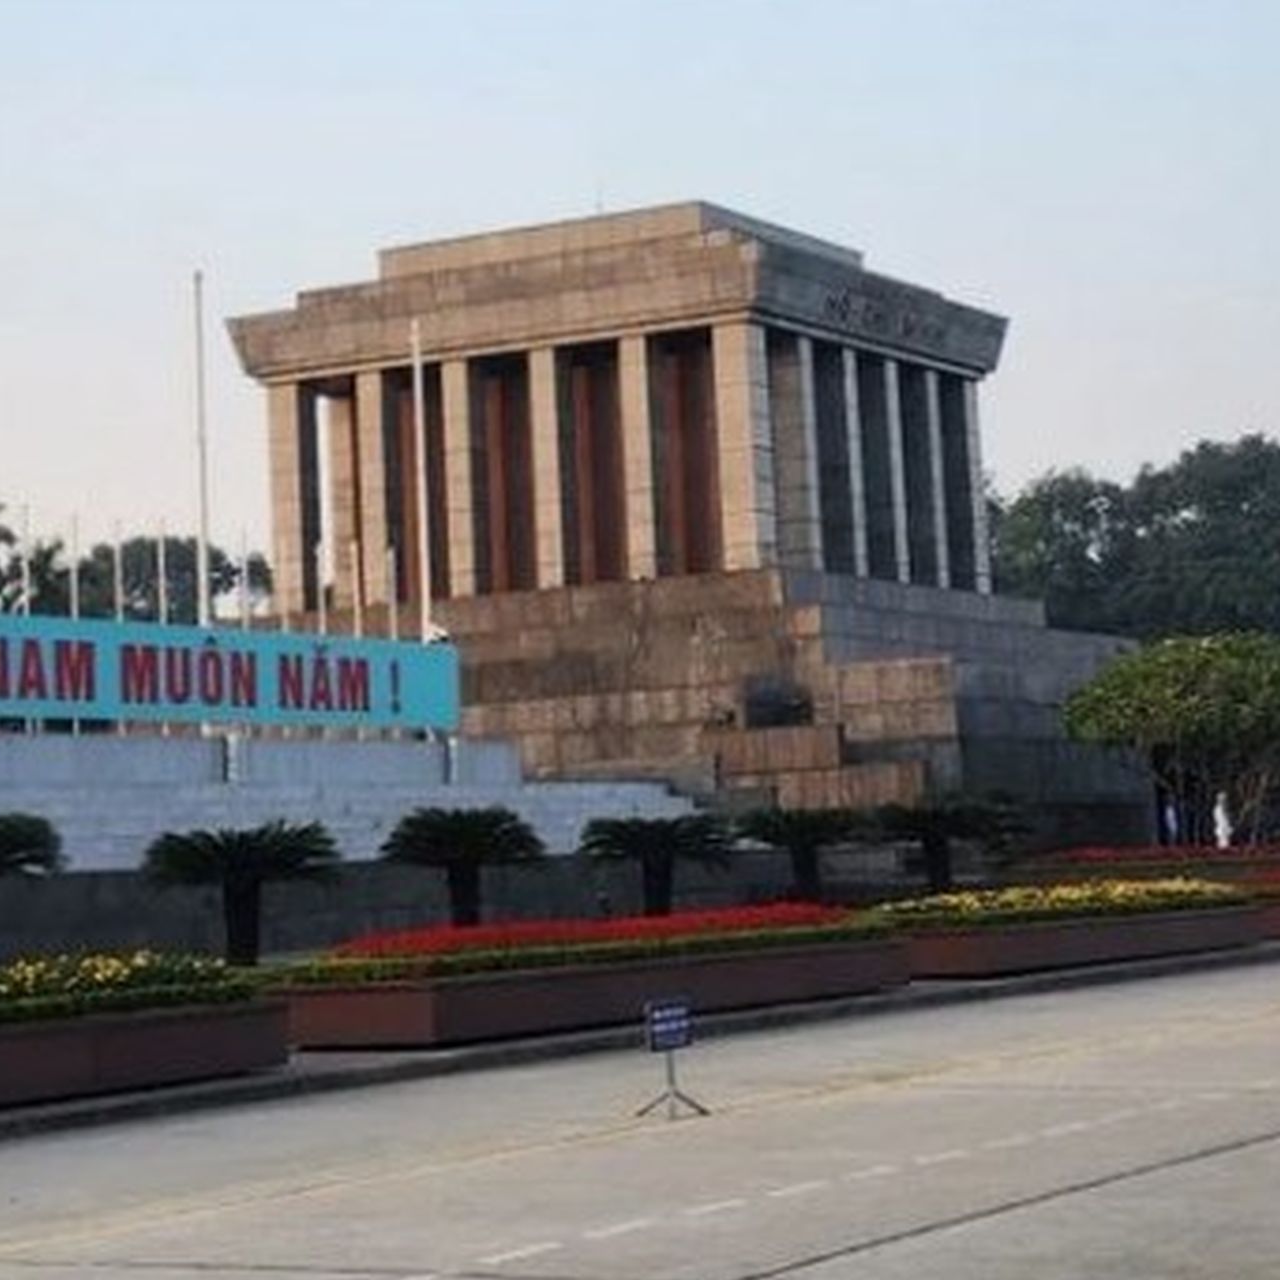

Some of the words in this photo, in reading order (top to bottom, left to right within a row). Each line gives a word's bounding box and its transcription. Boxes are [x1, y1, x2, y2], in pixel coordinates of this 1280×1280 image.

[119, 636, 258, 708] MUÔN
[278, 641, 370, 712] NĂM
[388, 658, 402, 714] !
